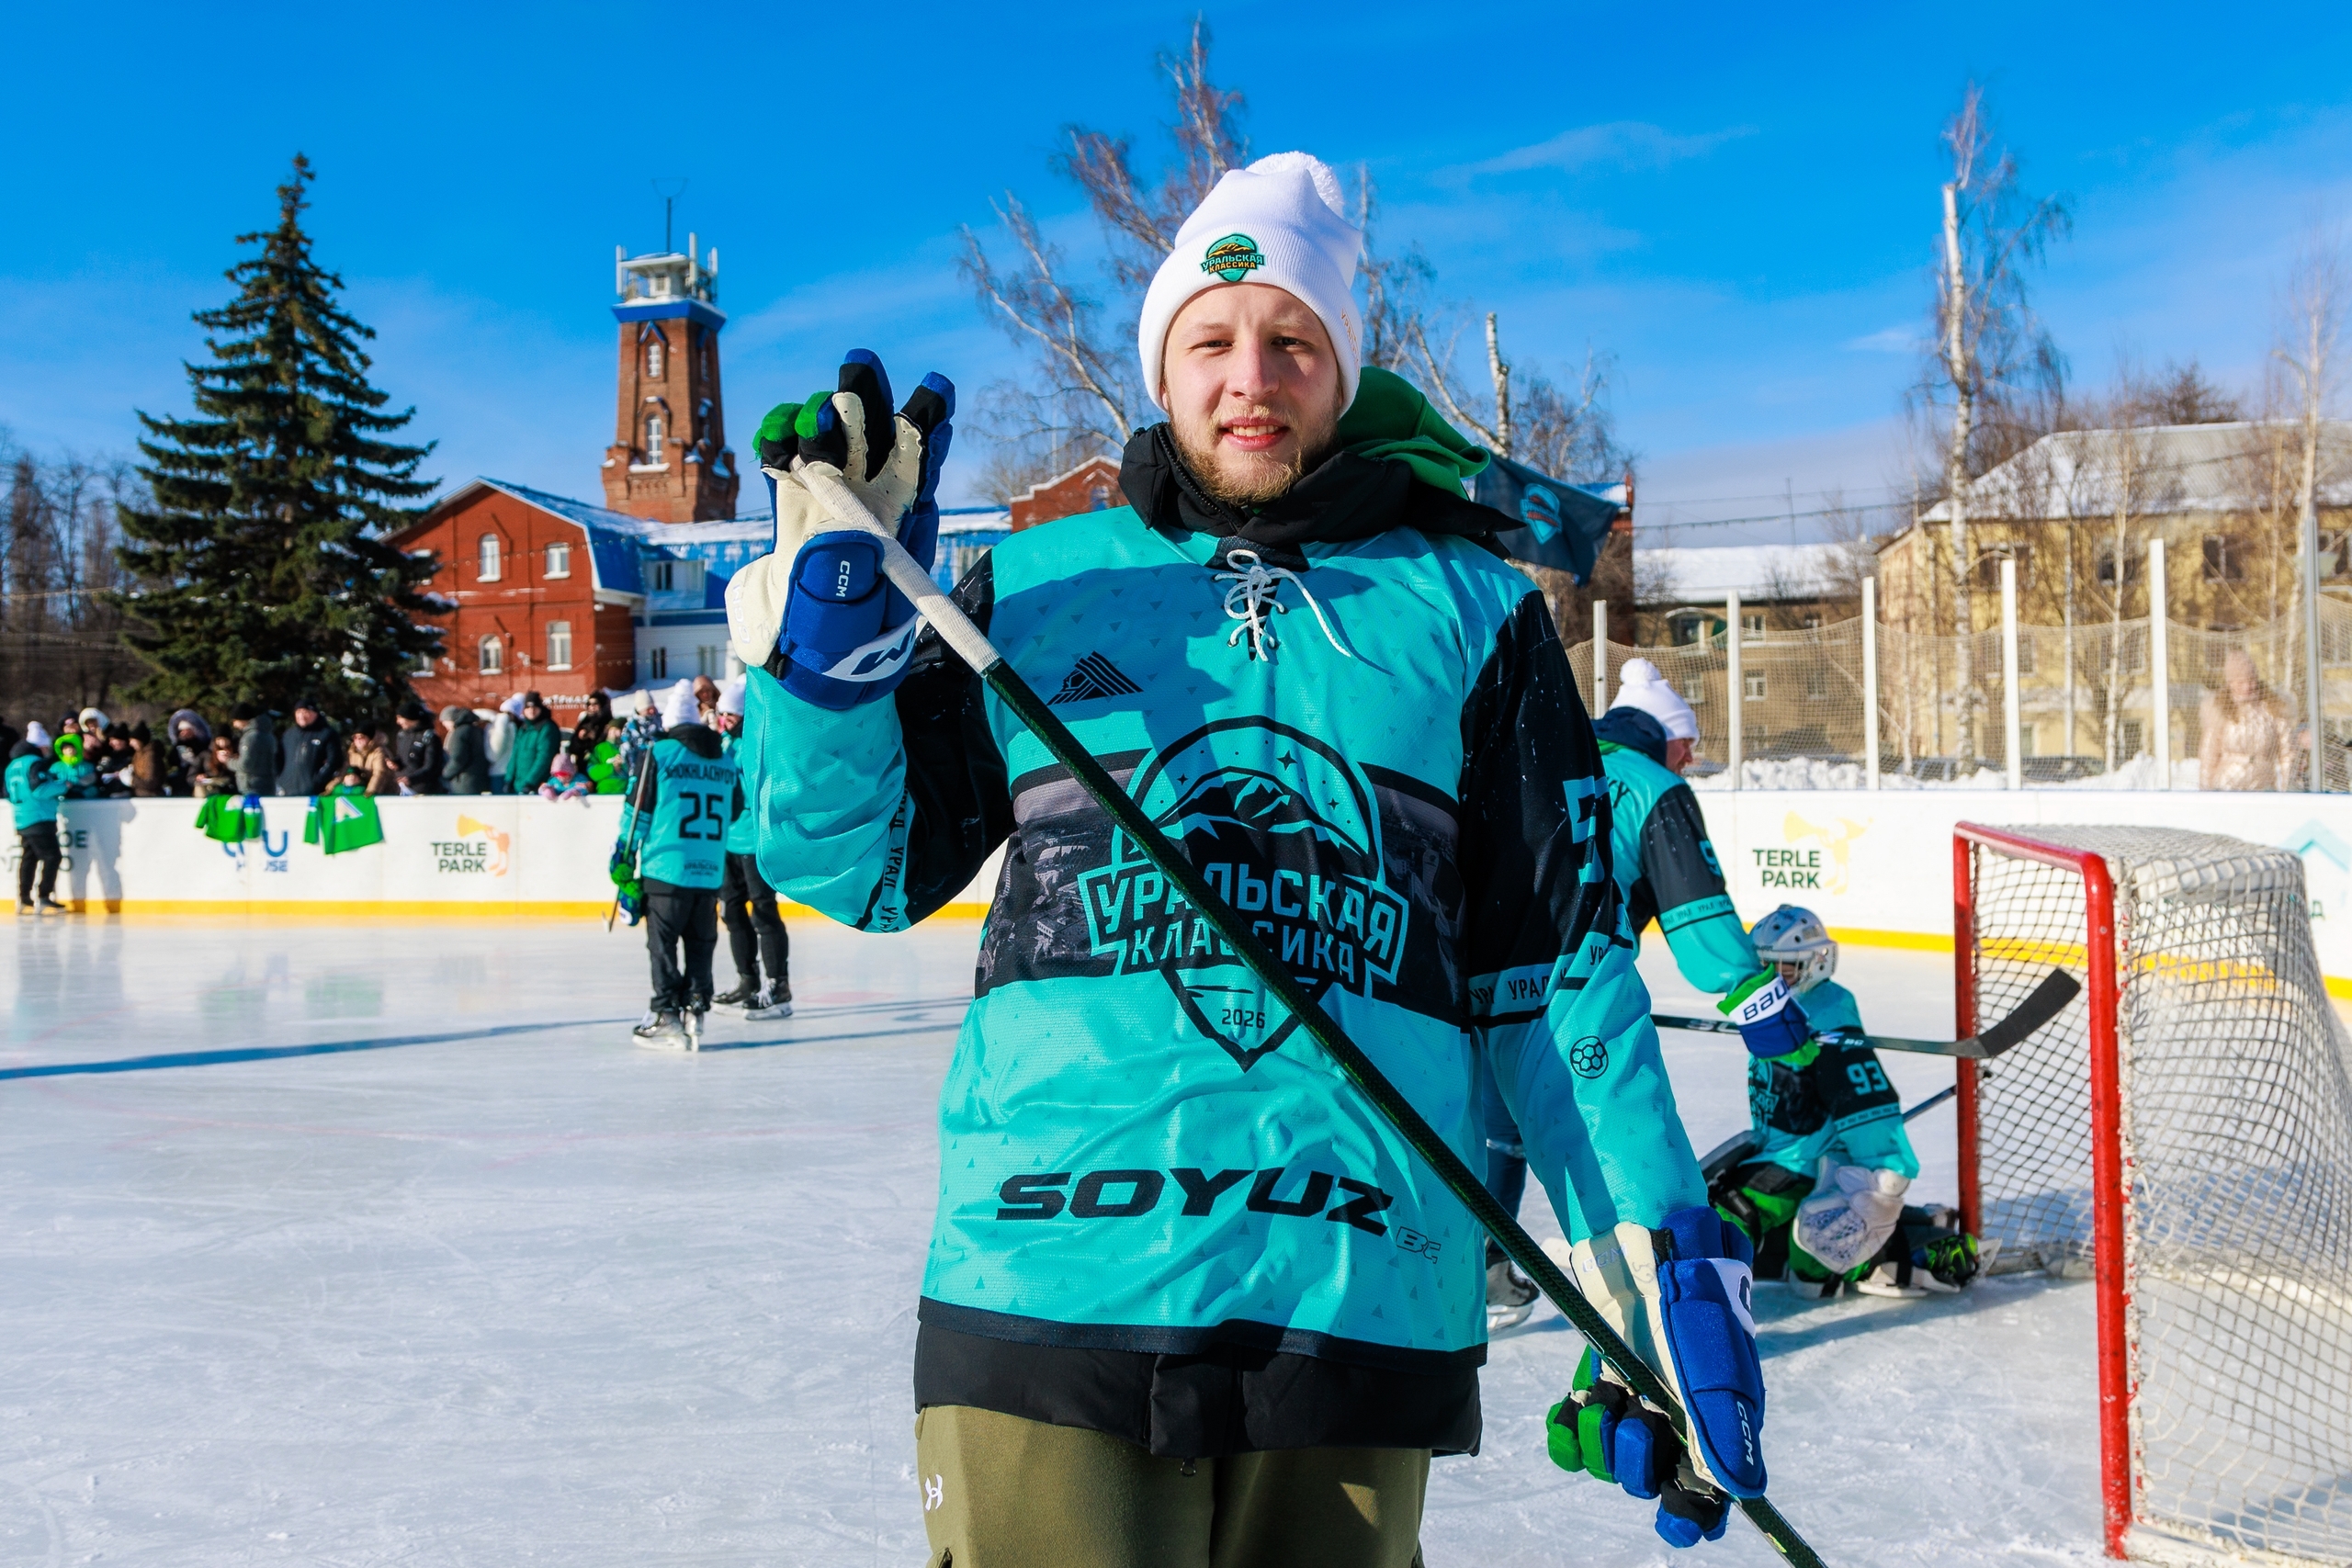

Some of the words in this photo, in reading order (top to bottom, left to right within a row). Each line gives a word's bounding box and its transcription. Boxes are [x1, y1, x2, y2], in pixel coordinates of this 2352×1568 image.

[1202, 254, 1263, 270] УРАЛЬСКАЯ
[1209, 261, 1256, 273] КЛАССИКА
[835, 559, 851, 597] CCM
[678, 792, 724, 841] 25
[430, 841, 487, 856] TERLE
[1752, 849, 1821, 867] TERLE
[438, 858, 486, 873] PARK
[884, 846, 904, 889] УРАЛ
[1762, 870, 1820, 889] PARK
[1096, 862, 1396, 961] УРАЛЬСКАЯ
[1470, 986, 1495, 1005] УРА
[1508, 976, 1550, 1001] УРАЛ
[1221, 1009, 1266, 1029] 2026
[1847, 1060, 1889, 1096] 93
[995, 1167, 1395, 1237] SOYUZ
[1582, 1242, 1628, 1273] CCM
[1736, 1401, 1754, 1466] CCM
